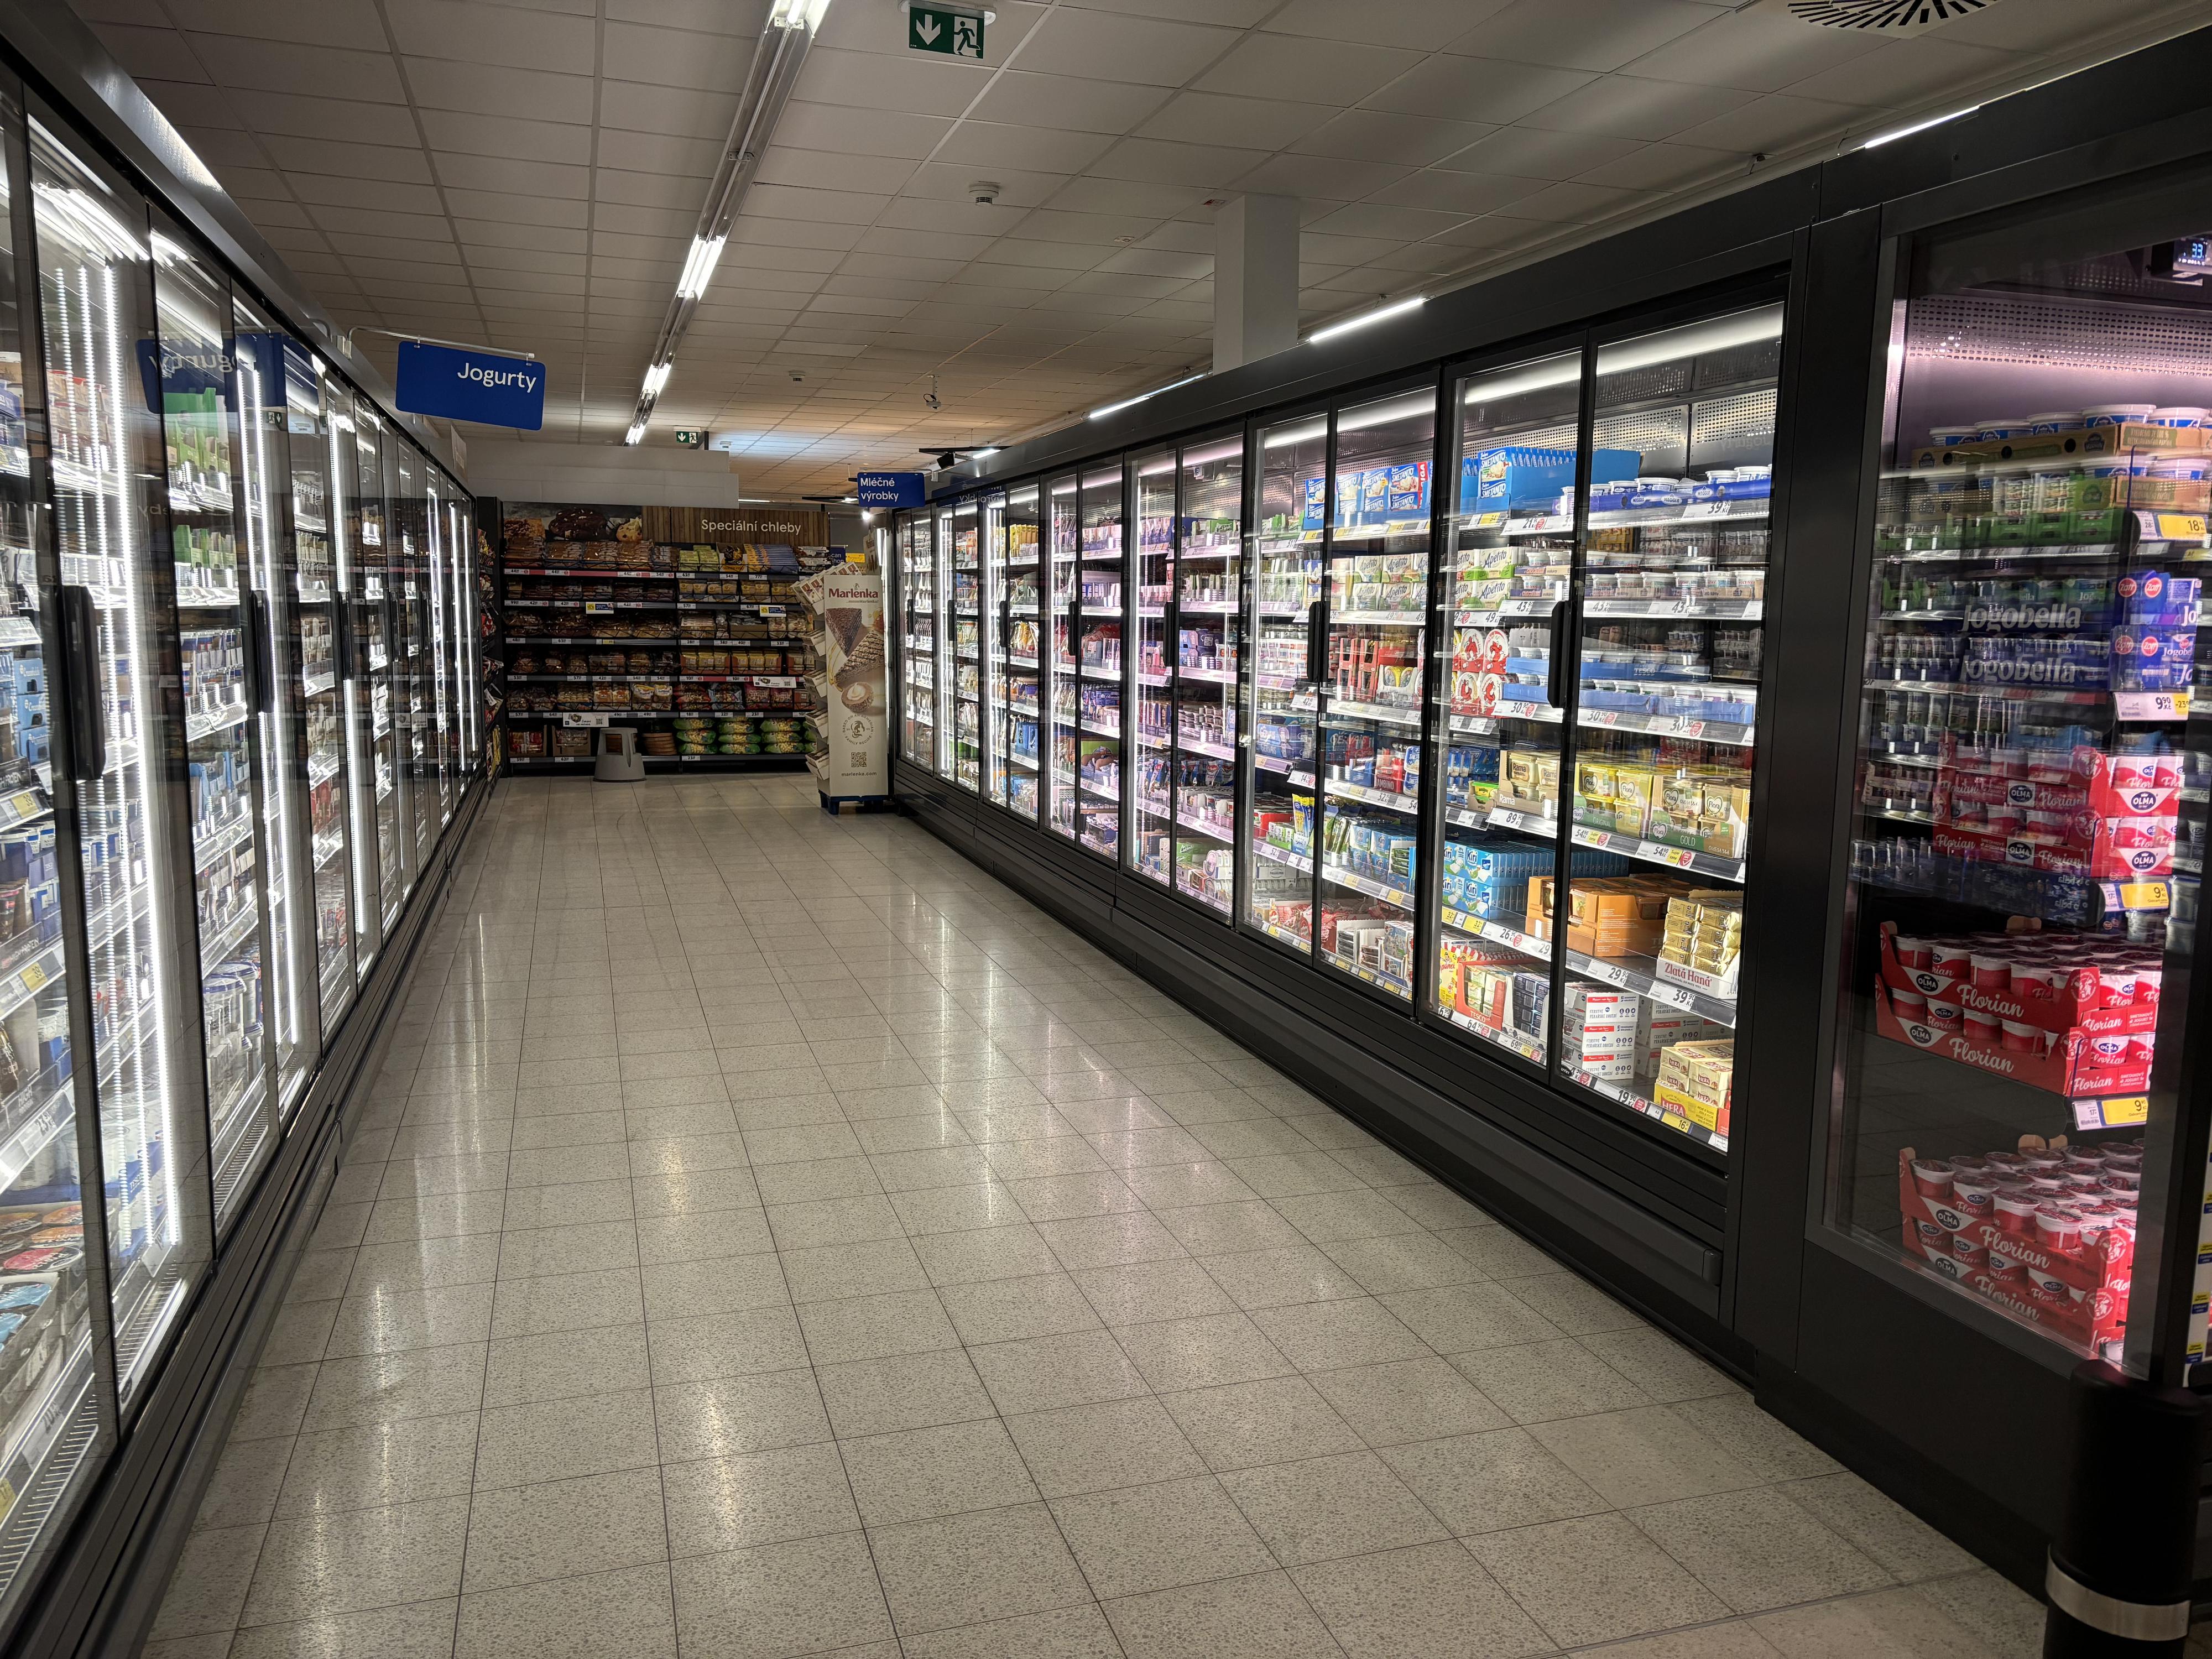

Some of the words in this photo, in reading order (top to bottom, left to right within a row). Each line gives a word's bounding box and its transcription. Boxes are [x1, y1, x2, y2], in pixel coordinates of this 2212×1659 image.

[457, 363, 536, 393] Jogurty
[860, 478, 895, 487] Mléčné
[861, 491, 899, 502] výrobky
[1708, 502, 1721, 514] 39
[702, 520, 758, 533] Speciální
[761, 521, 802, 535] chleby
[2188, 520, 2199, 531] 18
[1388, 557, 1407, 572] Apetito
[1457, 554, 1470, 565] etito
[1484, 550, 1507, 568] Apetito
[829, 588, 878, 598] Marlenka
[1480, 582, 1505, 599] Apetito
[1517, 602, 1526, 612] 43
[1486, 612, 1495, 623] 49
[1962, 603, 2081, 632] Jogobella
[1960, 653, 2075, 684] Jogobella
[1511, 702, 1522, 713] 30
[2156, 697, 2163, 709] 9
[1588, 711, 1600, 721] 30
[1513, 763, 1526, 773] Rama
[1375, 778, 1394, 790] AMBINO
[1499, 794, 1515, 805] Rama
[2011, 790, 2031, 799] OLMA
[1709, 801, 1720, 809] Flora
[1506, 813, 1517, 823] 89
[1593, 817, 1612, 828] ORIGINAL
[1575, 829, 1584, 839] 54
[1680, 836, 1695, 846] GOLD
[1936, 834, 1976, 849] Florian
[1467, 848, 1478, 863] Kiri
[1653, 847, 1664, 857] 54
[2009, 847, 2030, 855] OLMA
[1467, 881, 1477, 895] Kiri
[2154, 887, 2161, 898] 9
[1500, 928, 1509, 938] 26
[1538, 943, 1550, 954] 29
[1608, 967, 1621, 980] 29
[1665, 963, 1686, 979] Zlatá
[1688, 969, 1711, 987] Haná
[1918, 977, 1937, 989] OLMA
[1673, 989, 1687, 1004] 39
[1957, 984, 2025, 1018] Florian
[1470, 1010, 1486, 1022] TESCO
[1467, 1020, 1477, 1031] 64
[2082, 1016, 2123, 1032] Florian
[1912, 1029, 1929, 1040] OLMA
[1949, 1037, 2014, 1073] Florian
[1669, 1058, 1680, 1068] HERA
[1667, 1077, 1678, 1086] HERA
[1699, 1076, 1710, 1084] HERA
[2074, 1077, 2113, 1092] Florian
[1618, 1089, 1629, 1103] 19
[1662, 1101, 1684, 1117] HERA
[2135, 1100, 2142, 1112] 9
[1679, 1120, 1686, 1129] 16
[1938, 1214, 1958, 1227] OLMA
[1979, 1226, 2050, 1269] Florian
[1938, 1261, 1957, 1274] OLMA
[1975, 1276, 2039, 1321] Florian
